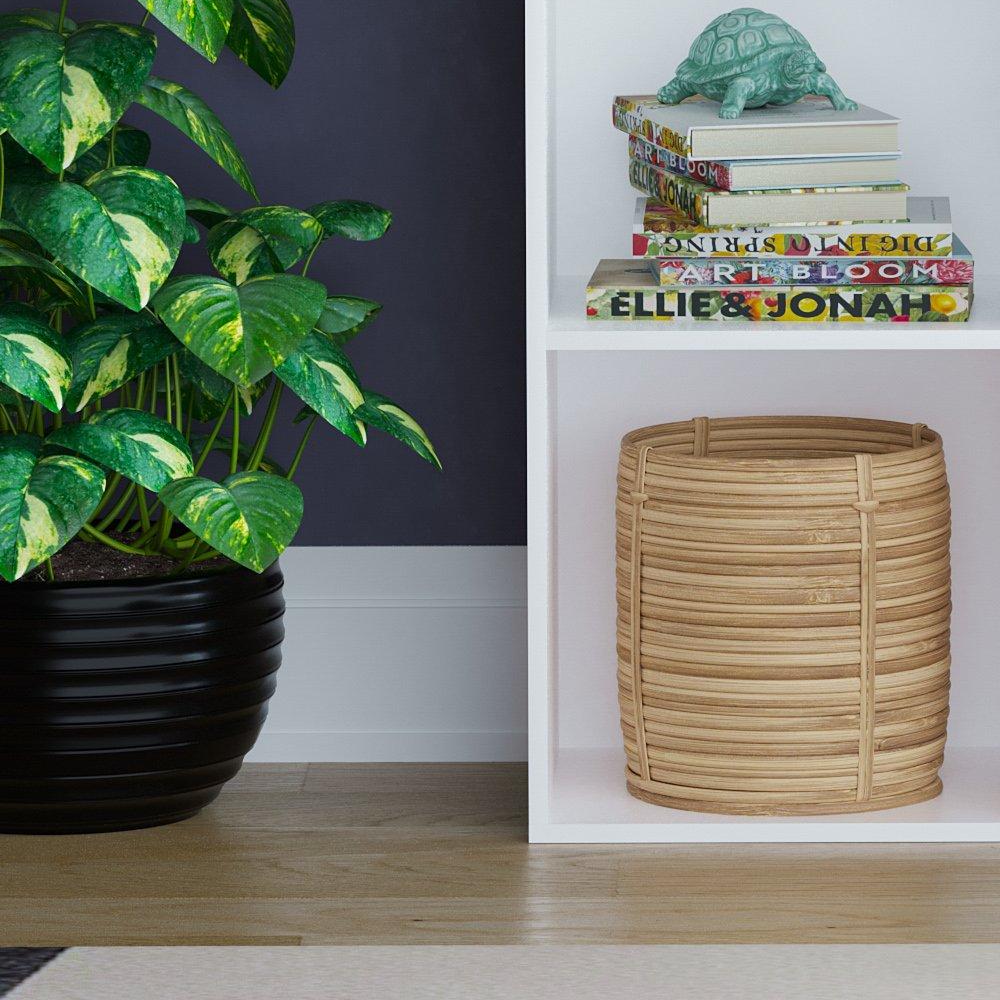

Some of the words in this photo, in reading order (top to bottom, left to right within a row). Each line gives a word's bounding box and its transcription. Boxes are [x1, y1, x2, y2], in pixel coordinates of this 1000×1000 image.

[634, 142, 661, 163] ART
[669, 154, 718, 182] BLOOM
[664, 236, 776, 253] SPRING
[792, 235, 867, 252] INTO
[881, 236, 933, 252] DIG
[678, 264, 767, 282] ART
[792, 263, 938, 280] BLOOM
[767, 292, 931, 318] JONAH
